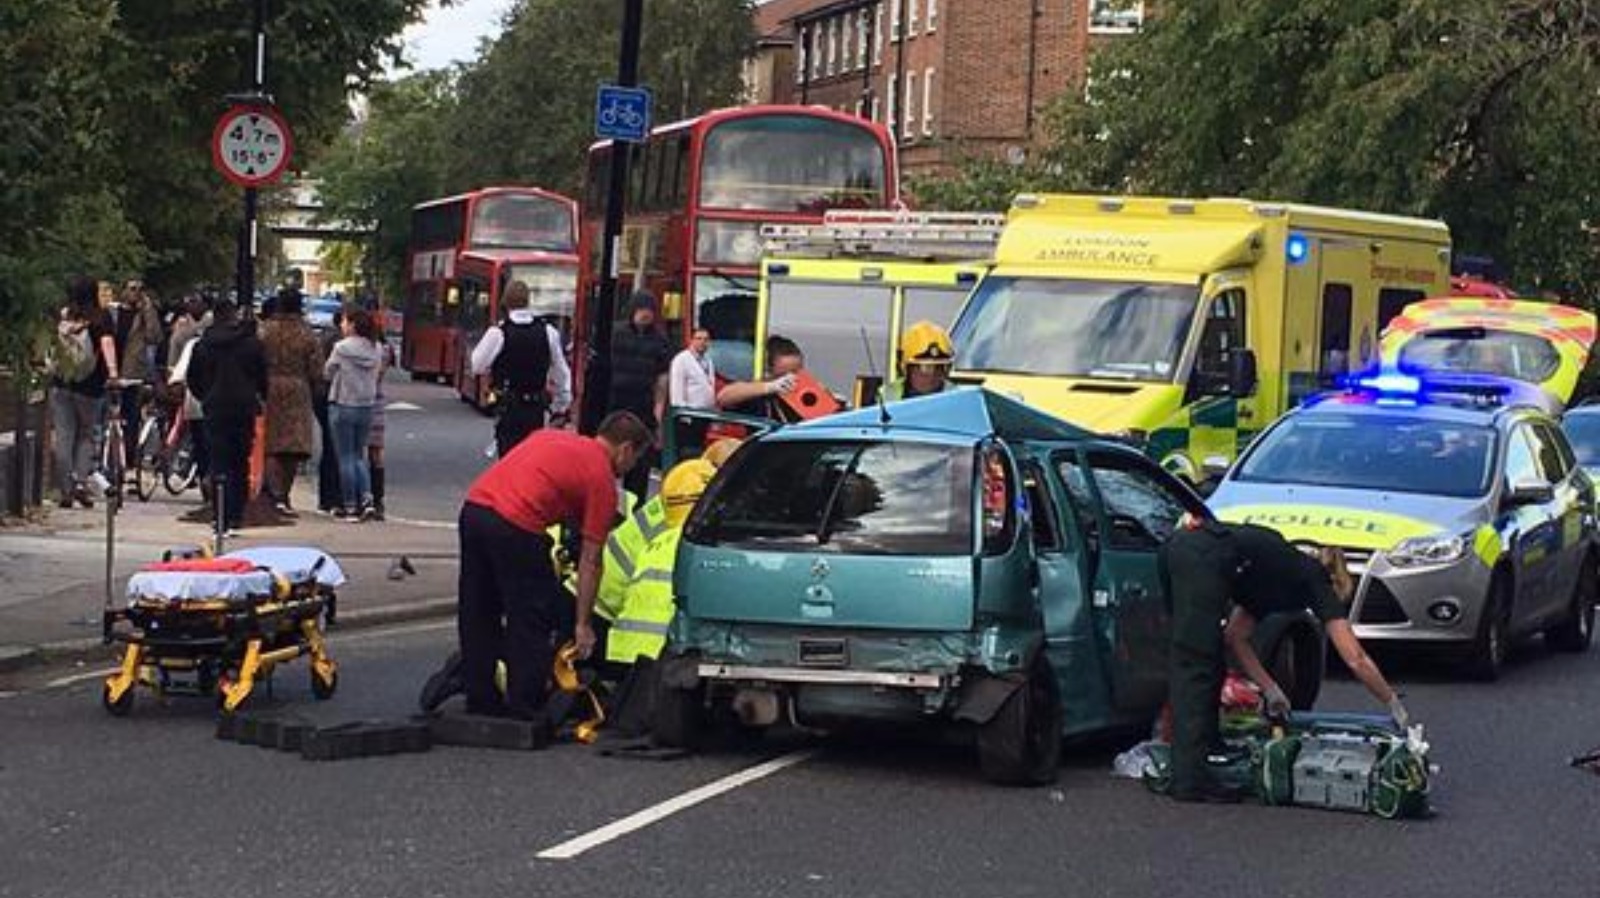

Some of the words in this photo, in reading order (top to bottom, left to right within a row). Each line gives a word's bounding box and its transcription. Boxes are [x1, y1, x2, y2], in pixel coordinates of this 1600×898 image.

[1063, 235, 1151, 248] LONDON
[1035, 248, 1158, 266] AMBULANCE
[1243, 513, 1388, 535] POLICE
